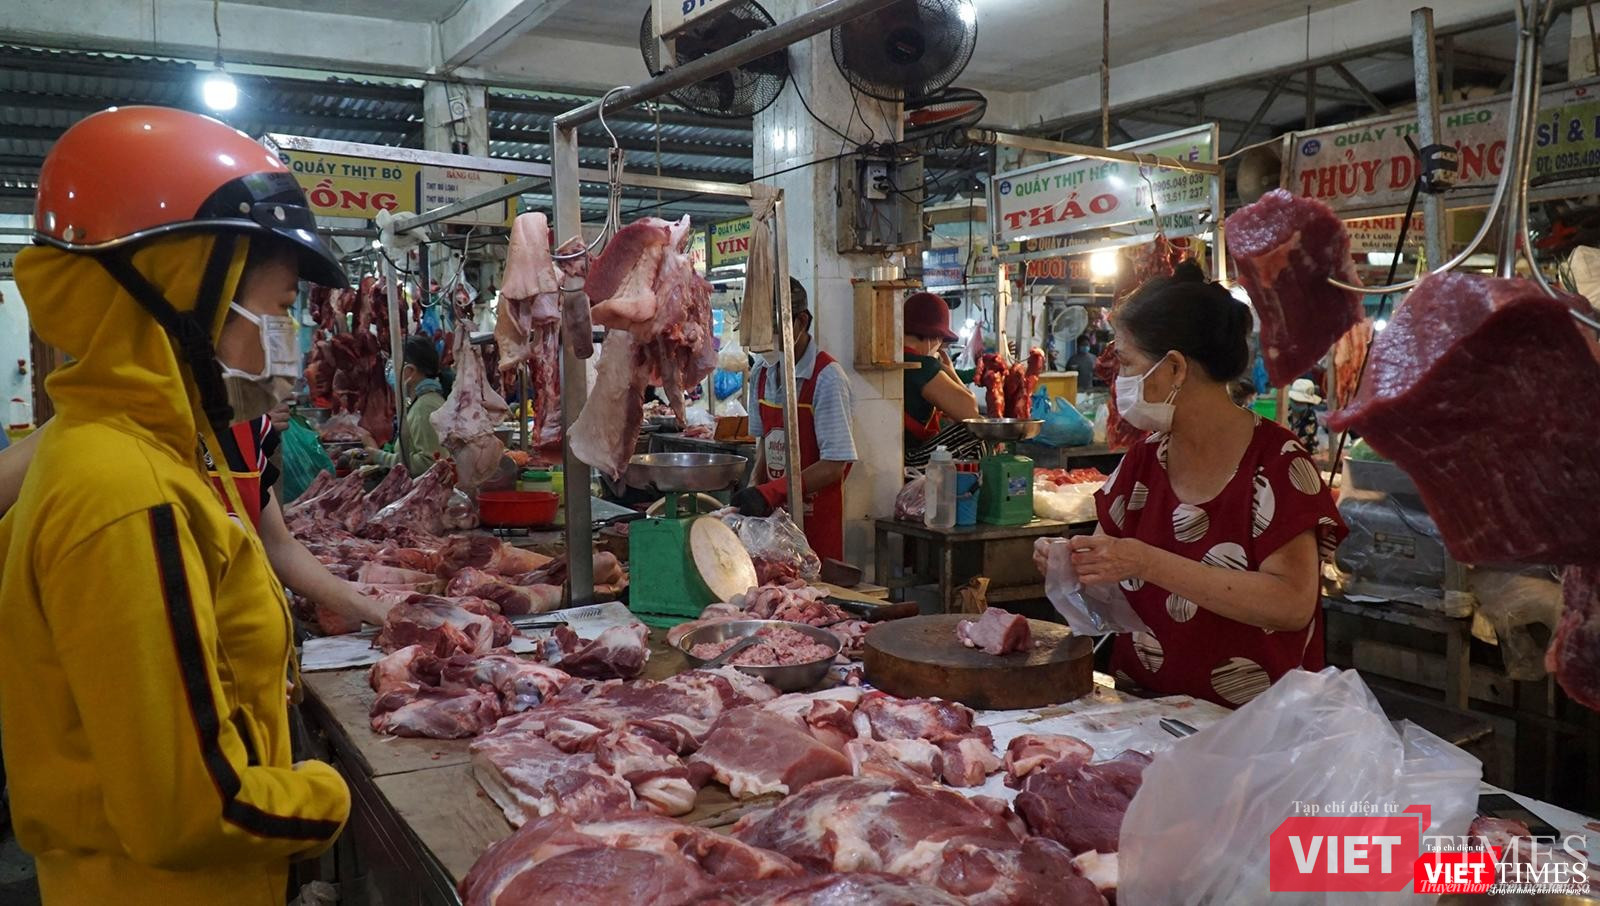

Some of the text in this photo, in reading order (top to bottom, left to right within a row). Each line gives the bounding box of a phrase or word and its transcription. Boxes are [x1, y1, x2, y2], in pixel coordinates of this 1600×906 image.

[1446, 109, 1492, 128] HEO
[1568, 118, 1584, 142] &
[341, 163, 376, 181] THỊT
[382, 166, 402, 180] BÒ
[1054, 169, 1085, 189] THỊT
[1300, 149, 1382, 199] THỦY
[300, 179, 399, 212] ỒNG
[1003, 191, 1120, 231] THẢO
